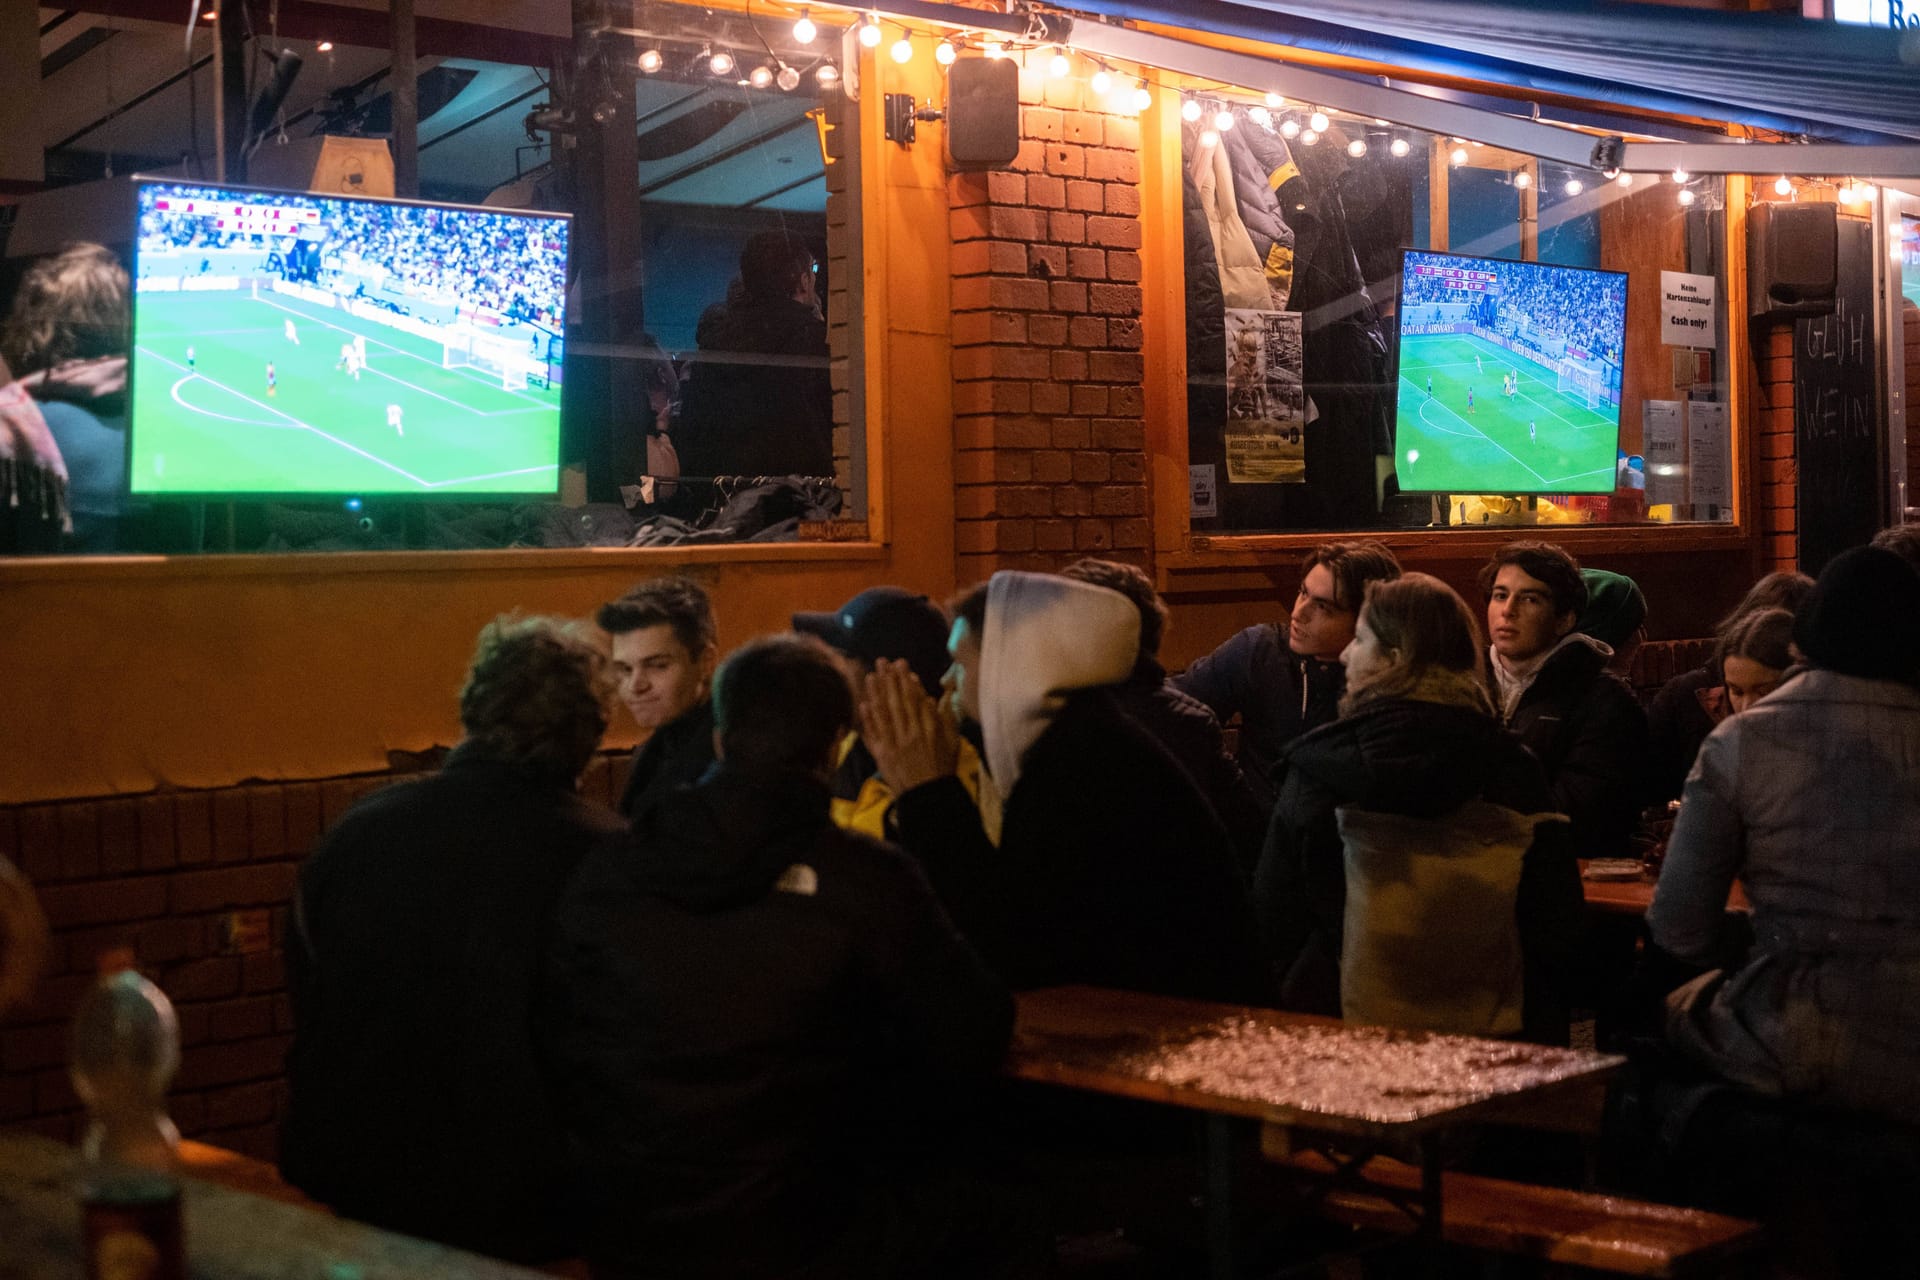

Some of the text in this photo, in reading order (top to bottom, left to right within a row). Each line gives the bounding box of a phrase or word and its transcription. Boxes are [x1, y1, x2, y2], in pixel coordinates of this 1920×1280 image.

[1681, 283, 1697, 292] Keine
[1666, 292, 1711, 306] Kartenzahlung!
[1400, 324, 1454, 335] QATAR AIRWAYS
[1671, 315, 1707, 330] Cash only!
[1807, 296, 1864, 365] GLÜH
[1801, 379, 1870, 440] WEIN
